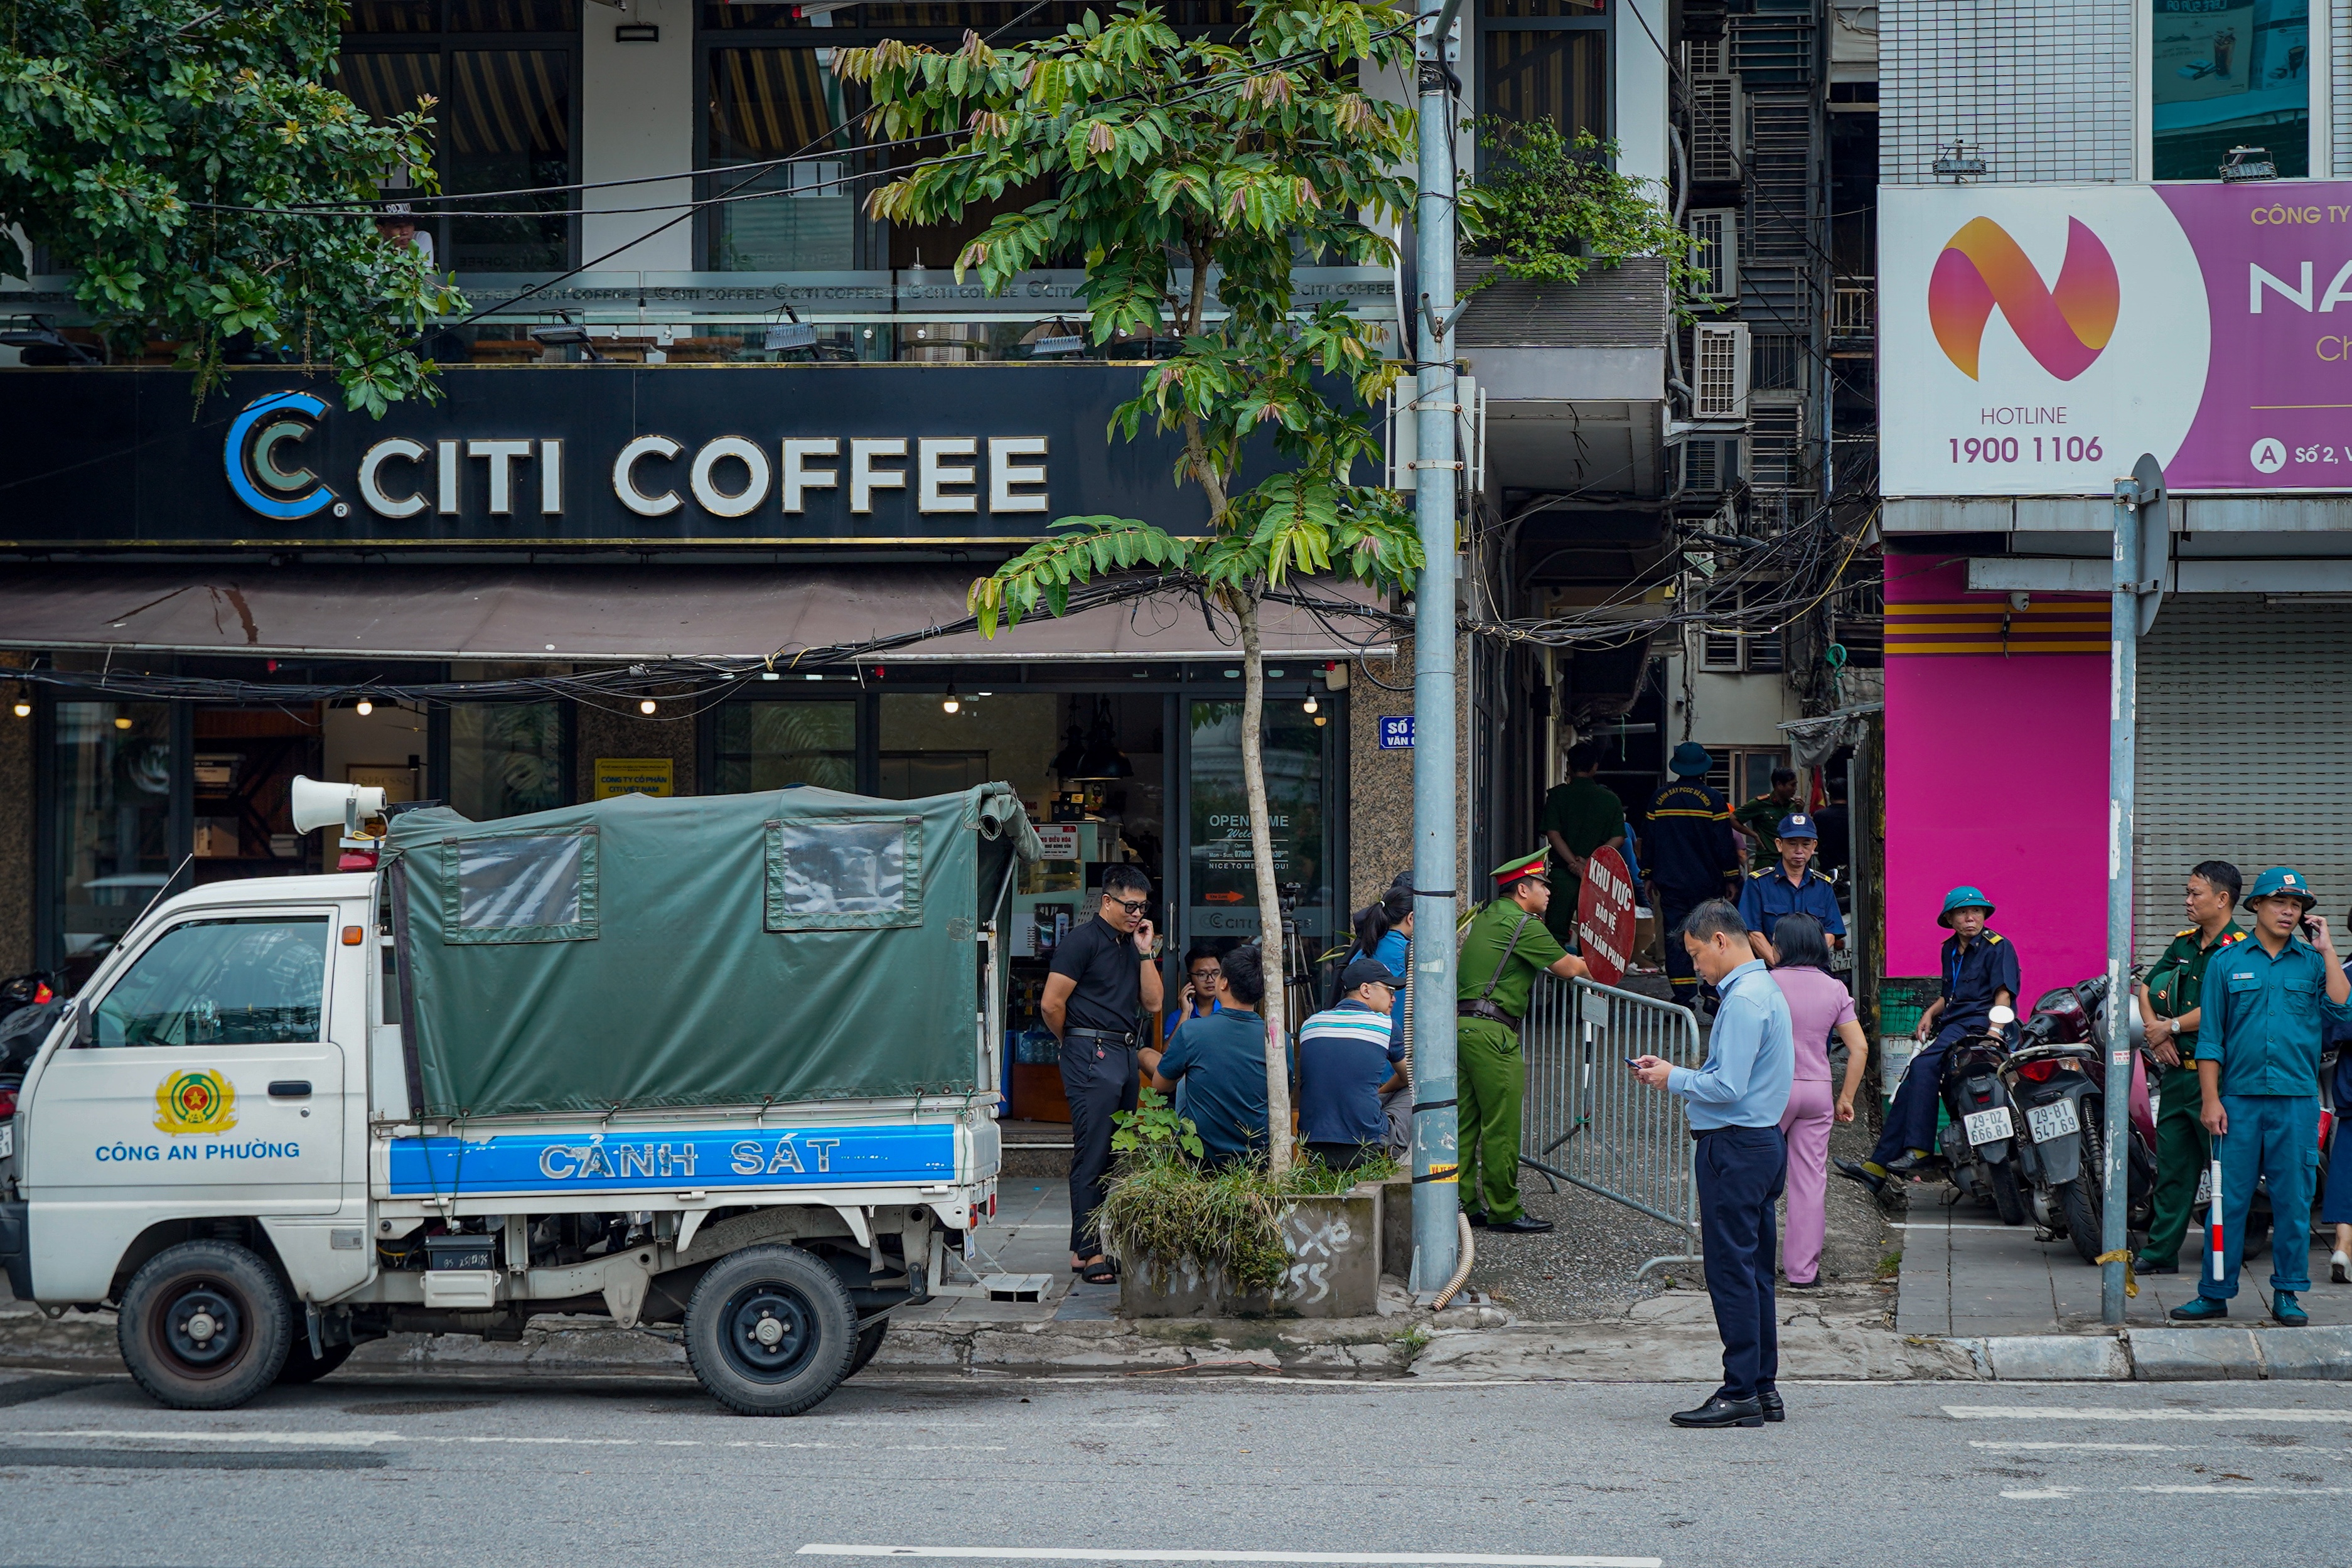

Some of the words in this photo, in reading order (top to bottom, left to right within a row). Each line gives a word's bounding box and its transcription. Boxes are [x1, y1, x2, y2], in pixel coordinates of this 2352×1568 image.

[2250, 203, 2322, 225] CÔNG
[2328, 205, 2351, 223] TY
[672, 289, 700, 299] CITI
[707, 289, 765, 299] COFFEE
[1981, 407, 2067, 426] HOTLINE
[1949, 437, 2019, 463] 1900
[2033, 436, 2103, 463] 1106
[2295, 444, 2319, 463] Số
[2322, 446, 2339, 464] 2,
[357, 436, 563, 518] CITI
[613, 434, 1050, 517] COFFEE
[1388, 719, 1407, 734] SỐ
[1387, 736, 1408, 746] VĂN
[1209, 814, 1249, 827] OPEN
[1269, 815, 1289, 827] ME
[1227, 828, 1252, 838] Welc
[1589, 857, 1611, 892] KHU
[1611, 876, 1632, 911] VỰC
[1226, 919, 1252, 928] CITI
[1595, 901, 1608, 924] BẢO
[1608, 912, 1617, 935] VỆ
[1579, 920, 1593, 946] CẤM
[1592, 935, 1608, 957] XÂM
[1607, 946, 1626, 973] PHẠM
[1972, 1112, 2003, 1129] 29-D2
[2034, 1103, 2068, 1125] 29-B1
[1971, 1123, 2010, 1142] 666.81
[2035, 1116, 2076, 1141] 547.69
[95, 1141, 159, 1162] CÔNG
[168, 1144, 197, 1161] AN
[205, 1137, 300, 1160] PHƯỜNG
[539, 1134, 696, 1179] CẢNH
[730, 1132, 840, 1176] SÁT
